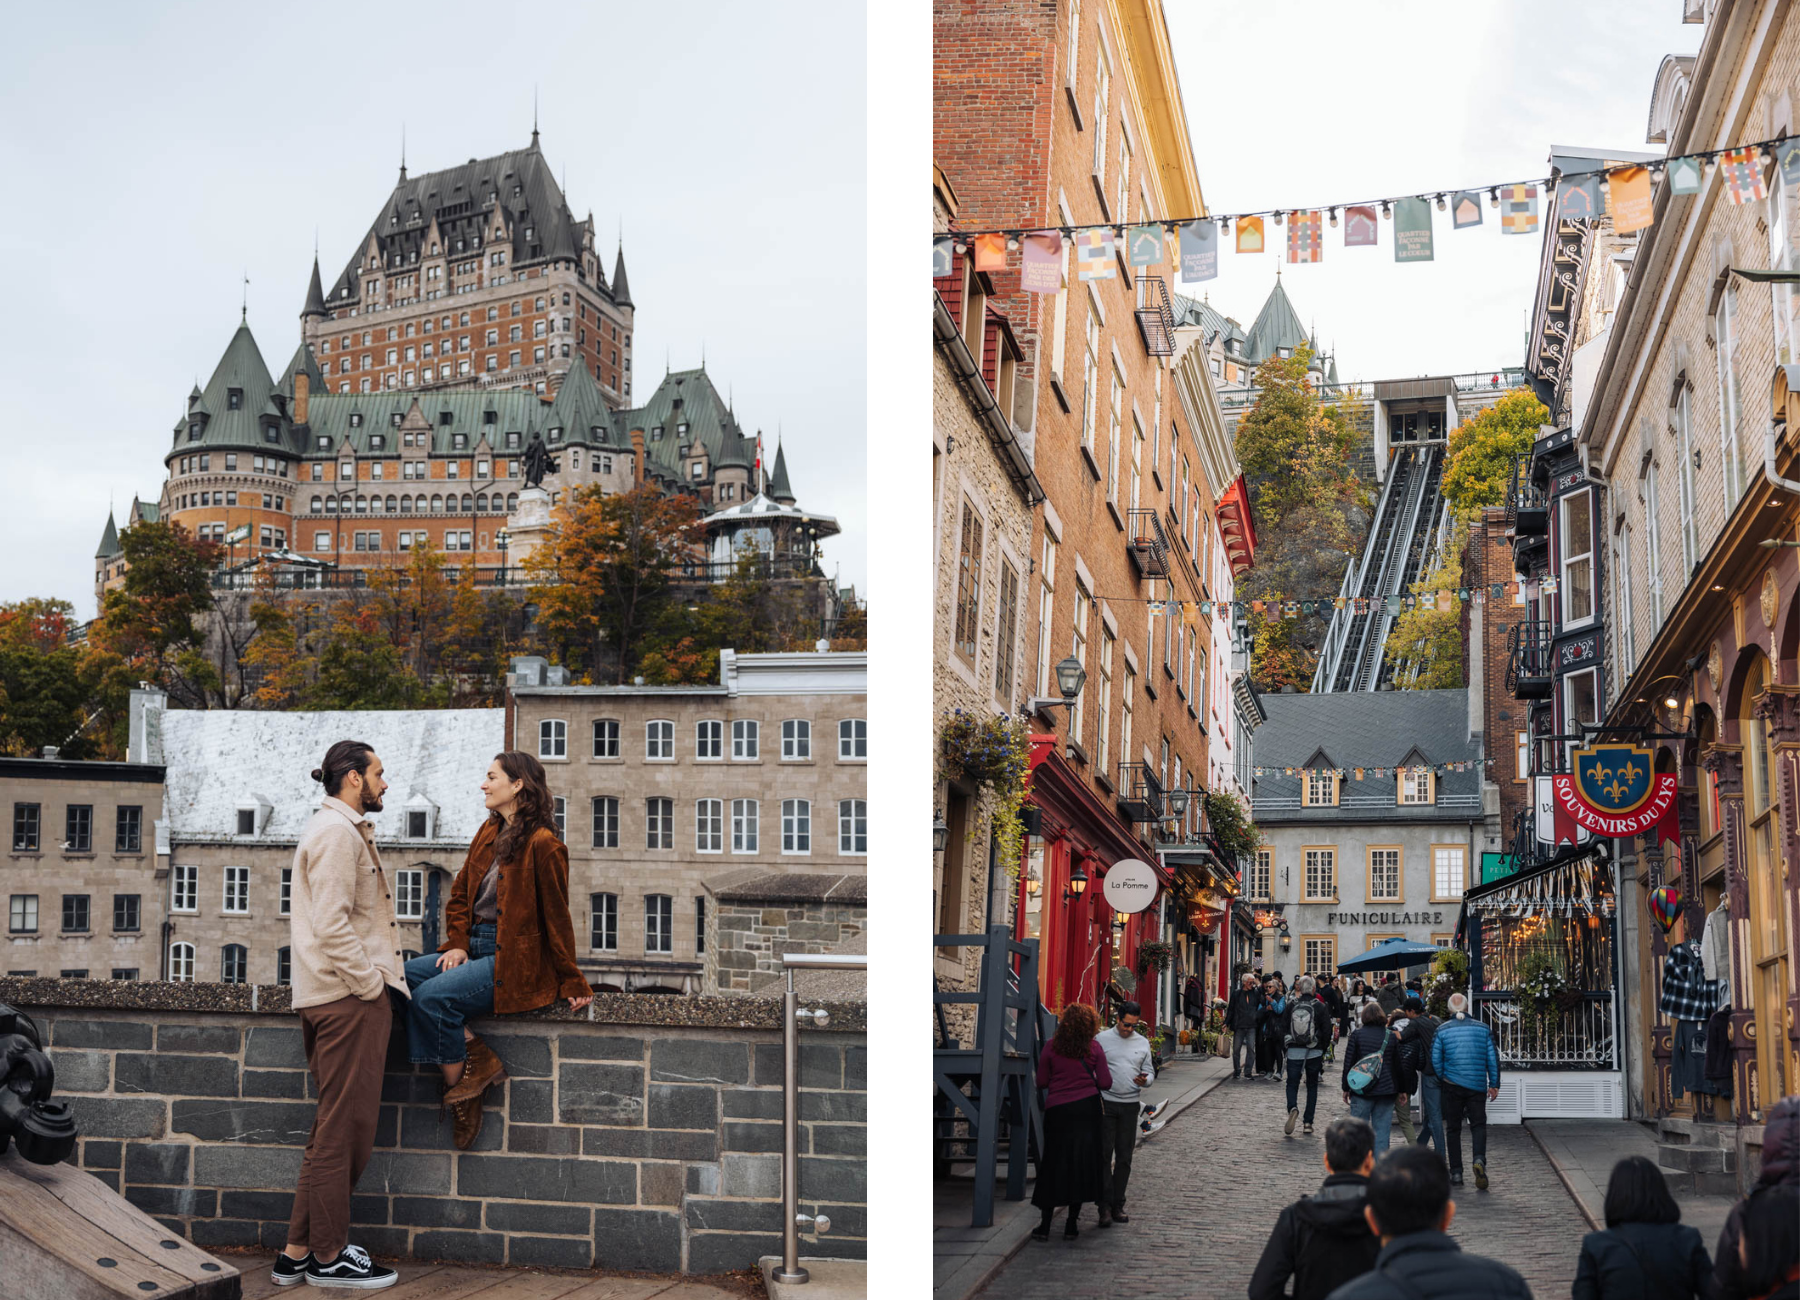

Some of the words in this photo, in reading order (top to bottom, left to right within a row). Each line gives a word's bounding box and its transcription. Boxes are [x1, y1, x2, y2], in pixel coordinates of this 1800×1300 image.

[1556, 777, 1638, 834] SOUVENIRS
[1638, 806, 1659, 827] DU
[1654, 776, 1676, 810] LYS
[1327, 911, 1443, 925] FUNICULAIRE
